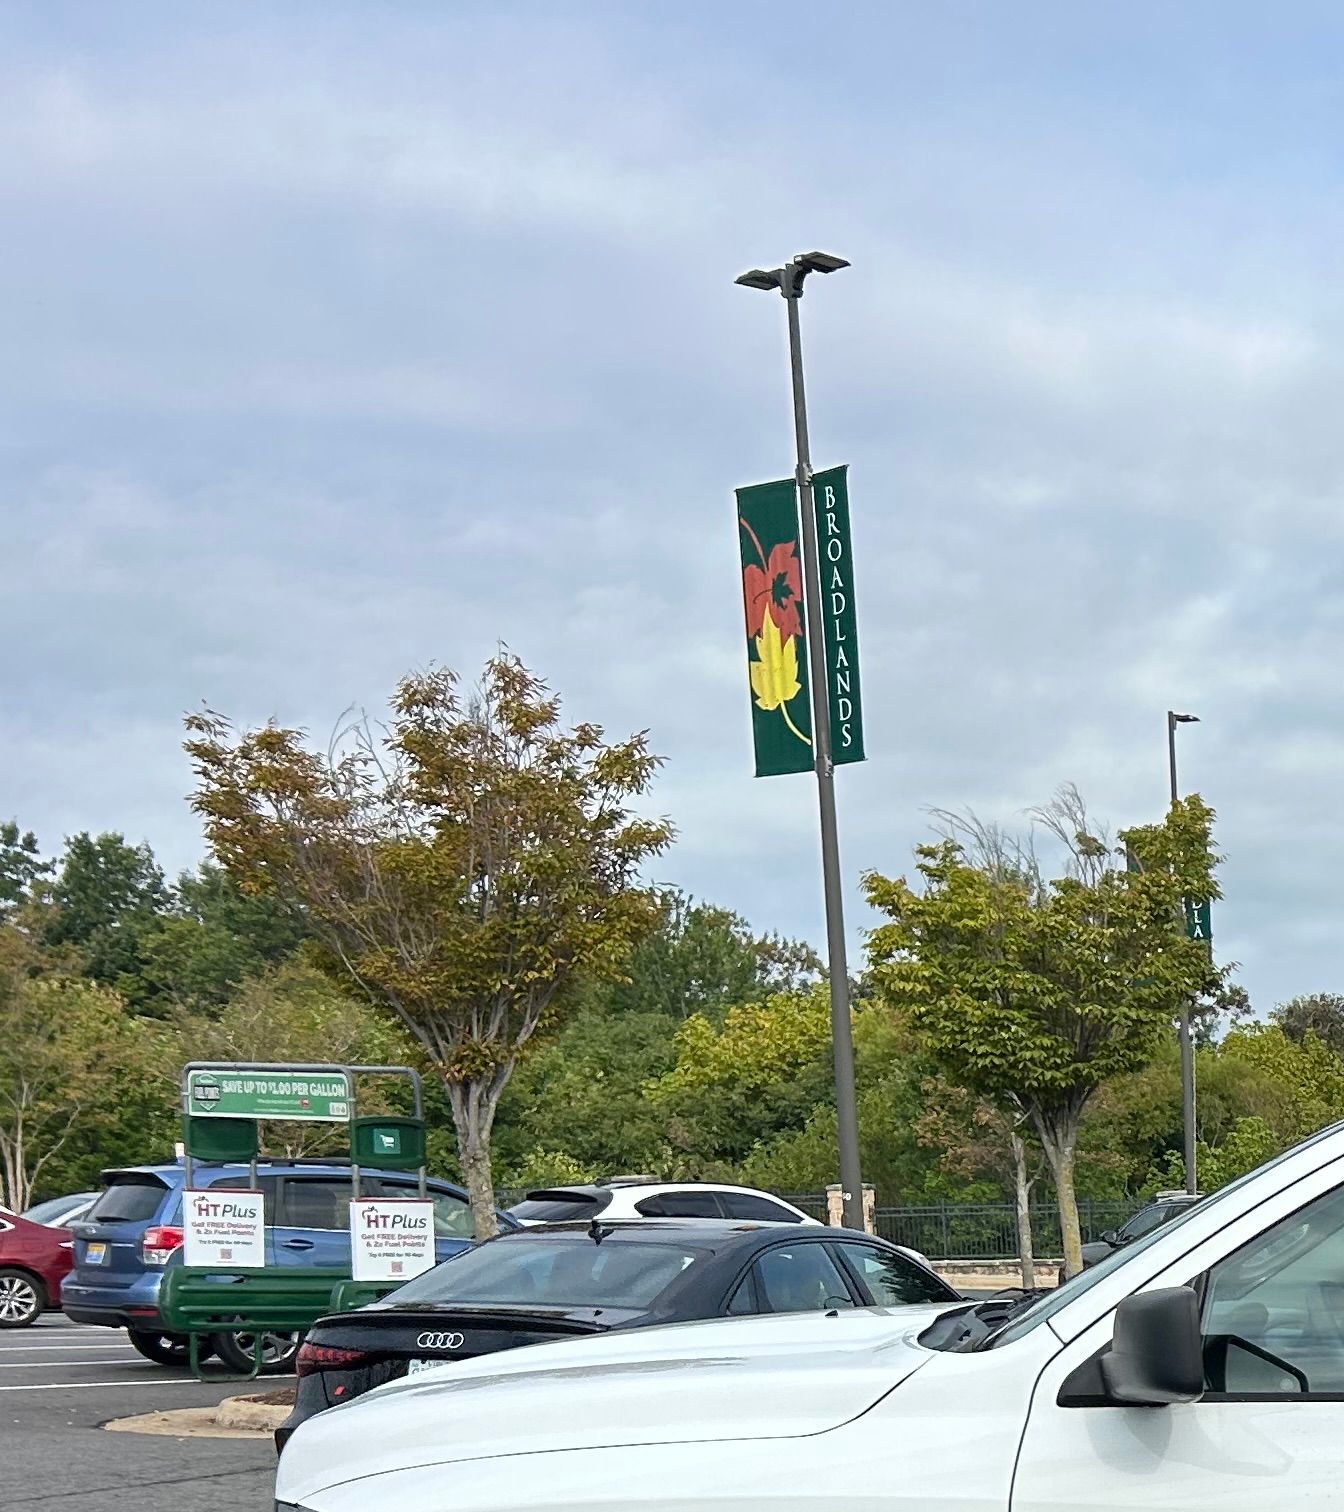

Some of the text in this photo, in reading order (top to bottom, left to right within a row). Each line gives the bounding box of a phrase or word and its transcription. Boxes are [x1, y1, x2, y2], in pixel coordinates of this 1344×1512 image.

[824, 485, 852, 748] BROADLANDS
[222, 1080, 243, 1094] SAVE
[243, 1080, 255, 1094] UP
[255, 1081, 268, 1094] TO
[291, 1082, 309, 1096] PER
[309, 1082, 345, 1097] GALLON
[197, 1203, 257, 1218] HT Plus
[366, 1213, 428, 1229] HT Plus
